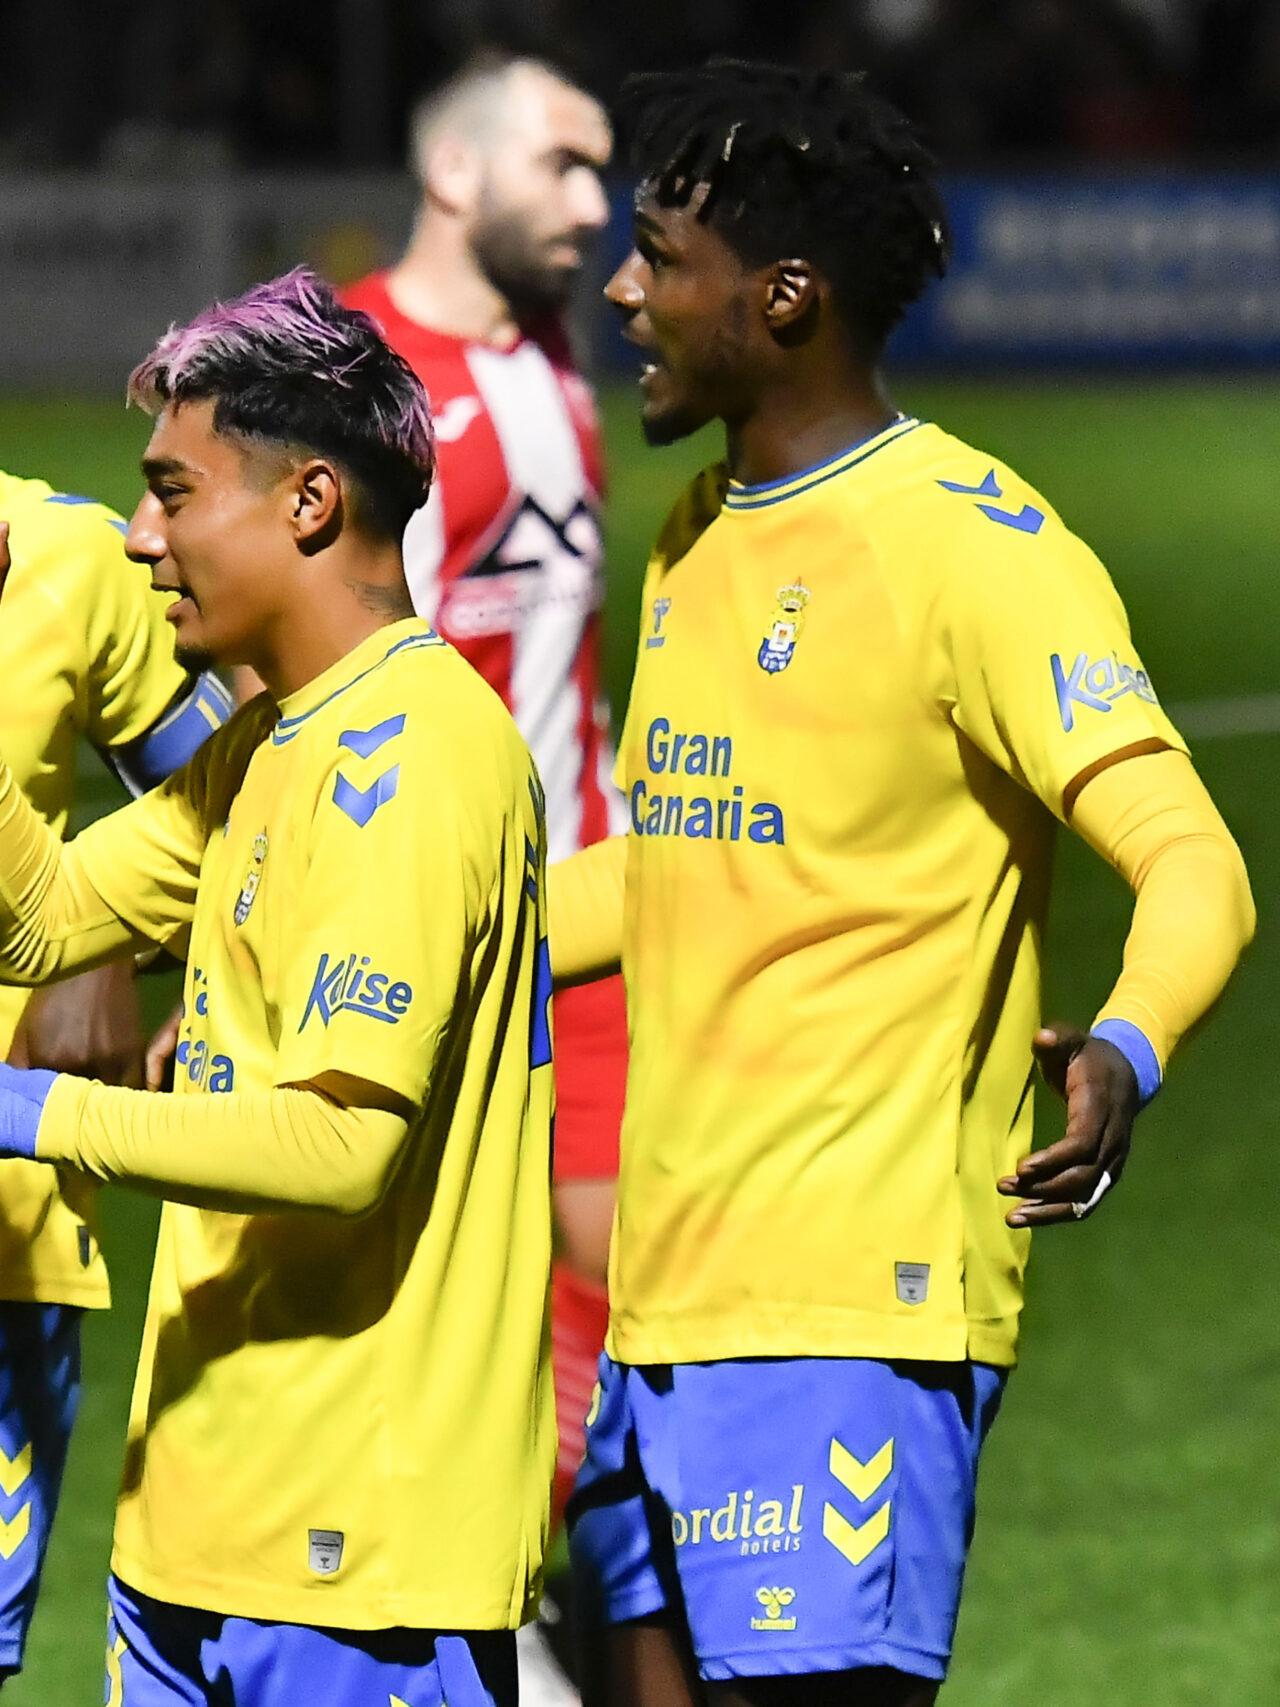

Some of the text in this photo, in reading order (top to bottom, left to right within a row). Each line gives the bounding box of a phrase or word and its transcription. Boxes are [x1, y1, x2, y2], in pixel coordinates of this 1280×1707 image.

[647, 717, 732, 777] Gran
[631, 779, 785, 846] Canaria
[672, 1483, 805, 1547] ordial
[740, 1535, 801, 1557] hotels
